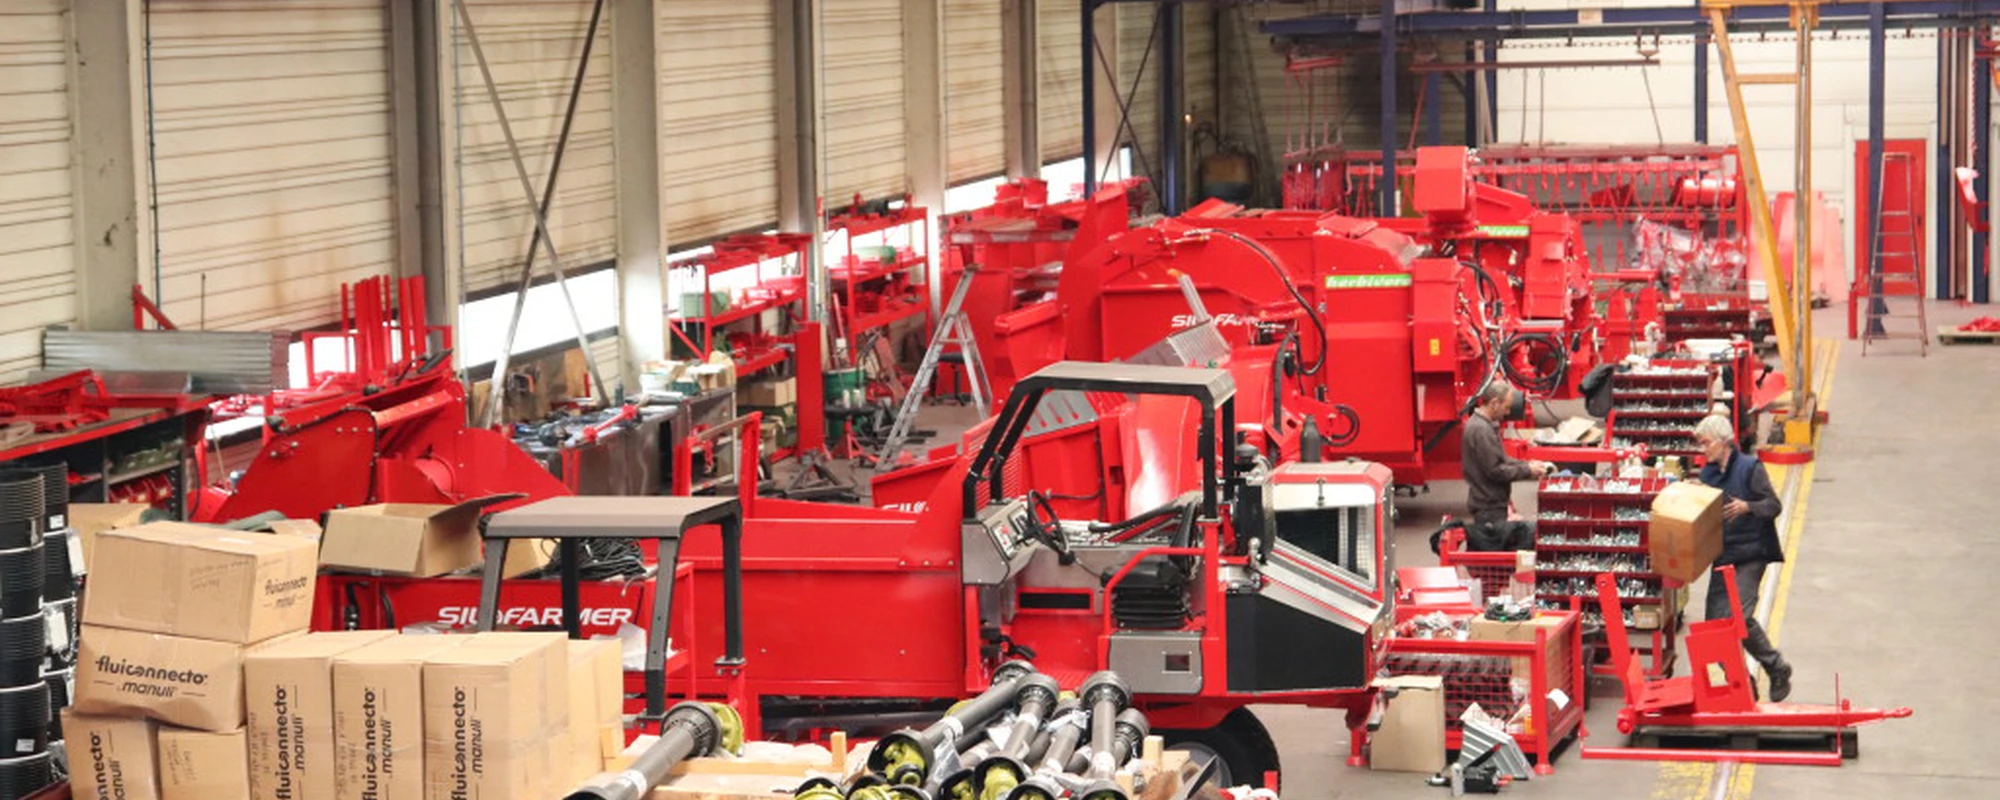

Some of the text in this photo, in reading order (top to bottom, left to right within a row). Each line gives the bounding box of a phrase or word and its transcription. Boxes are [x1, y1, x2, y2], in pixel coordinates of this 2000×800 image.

[437, 606, 633, 626] SILFARER
[95, 655, 208, 685] fluiconnecto
[119, 681, 177, 697] manuli
[274, 685, 292, 800] fluiconnecto
[292, 714, 305, 772] manuli
[380, 716, 393, 775] manuli
[470, 717, 483, 774] manuli
